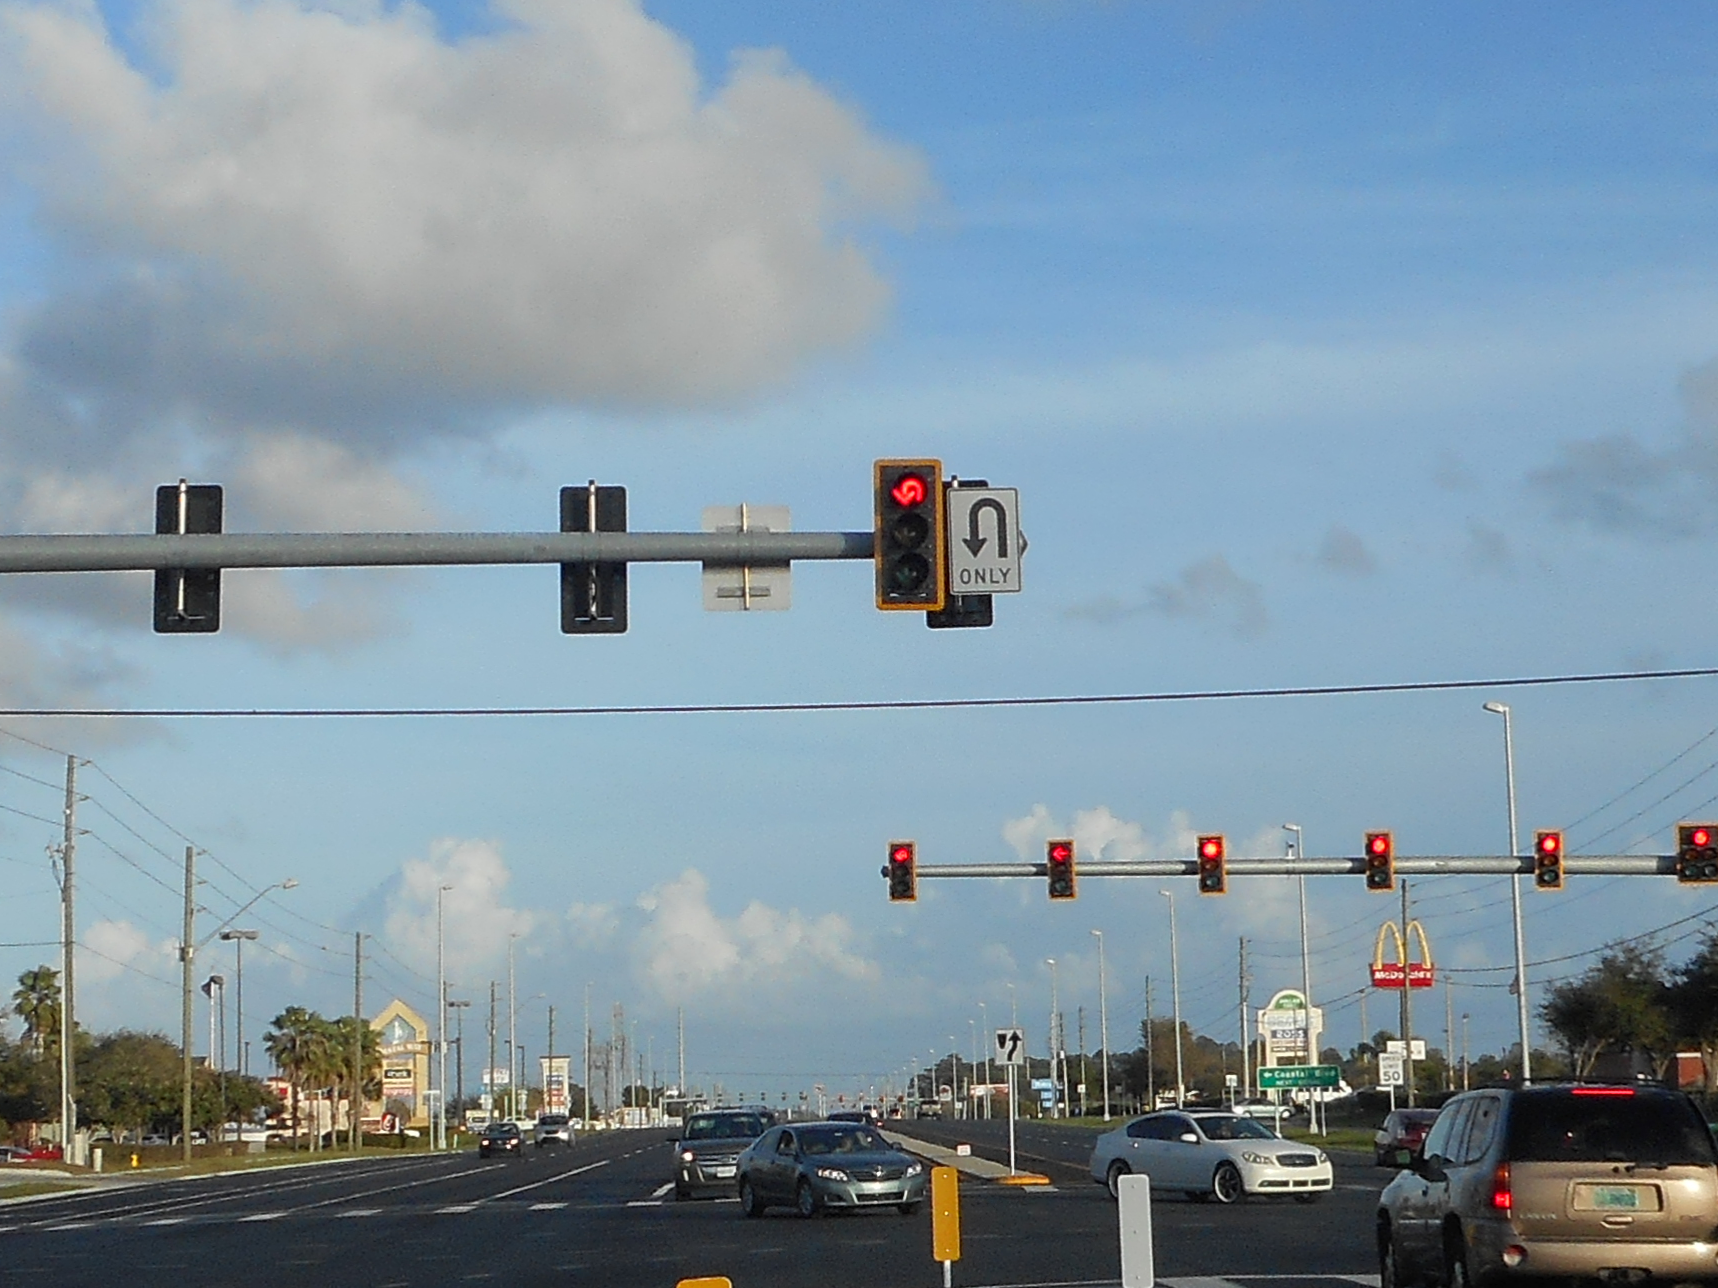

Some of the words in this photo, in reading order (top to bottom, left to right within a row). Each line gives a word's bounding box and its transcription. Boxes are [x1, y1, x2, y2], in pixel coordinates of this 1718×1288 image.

[960, 568, 1011, 585] ONLY
[1374, 970, 1432, 980] McDoald's
[1276, 1030, 1304, 1039] ROSS
[1274, 1070, 1307, 1079] Coastal
[1383, 1071, 1401, 1082] 50
